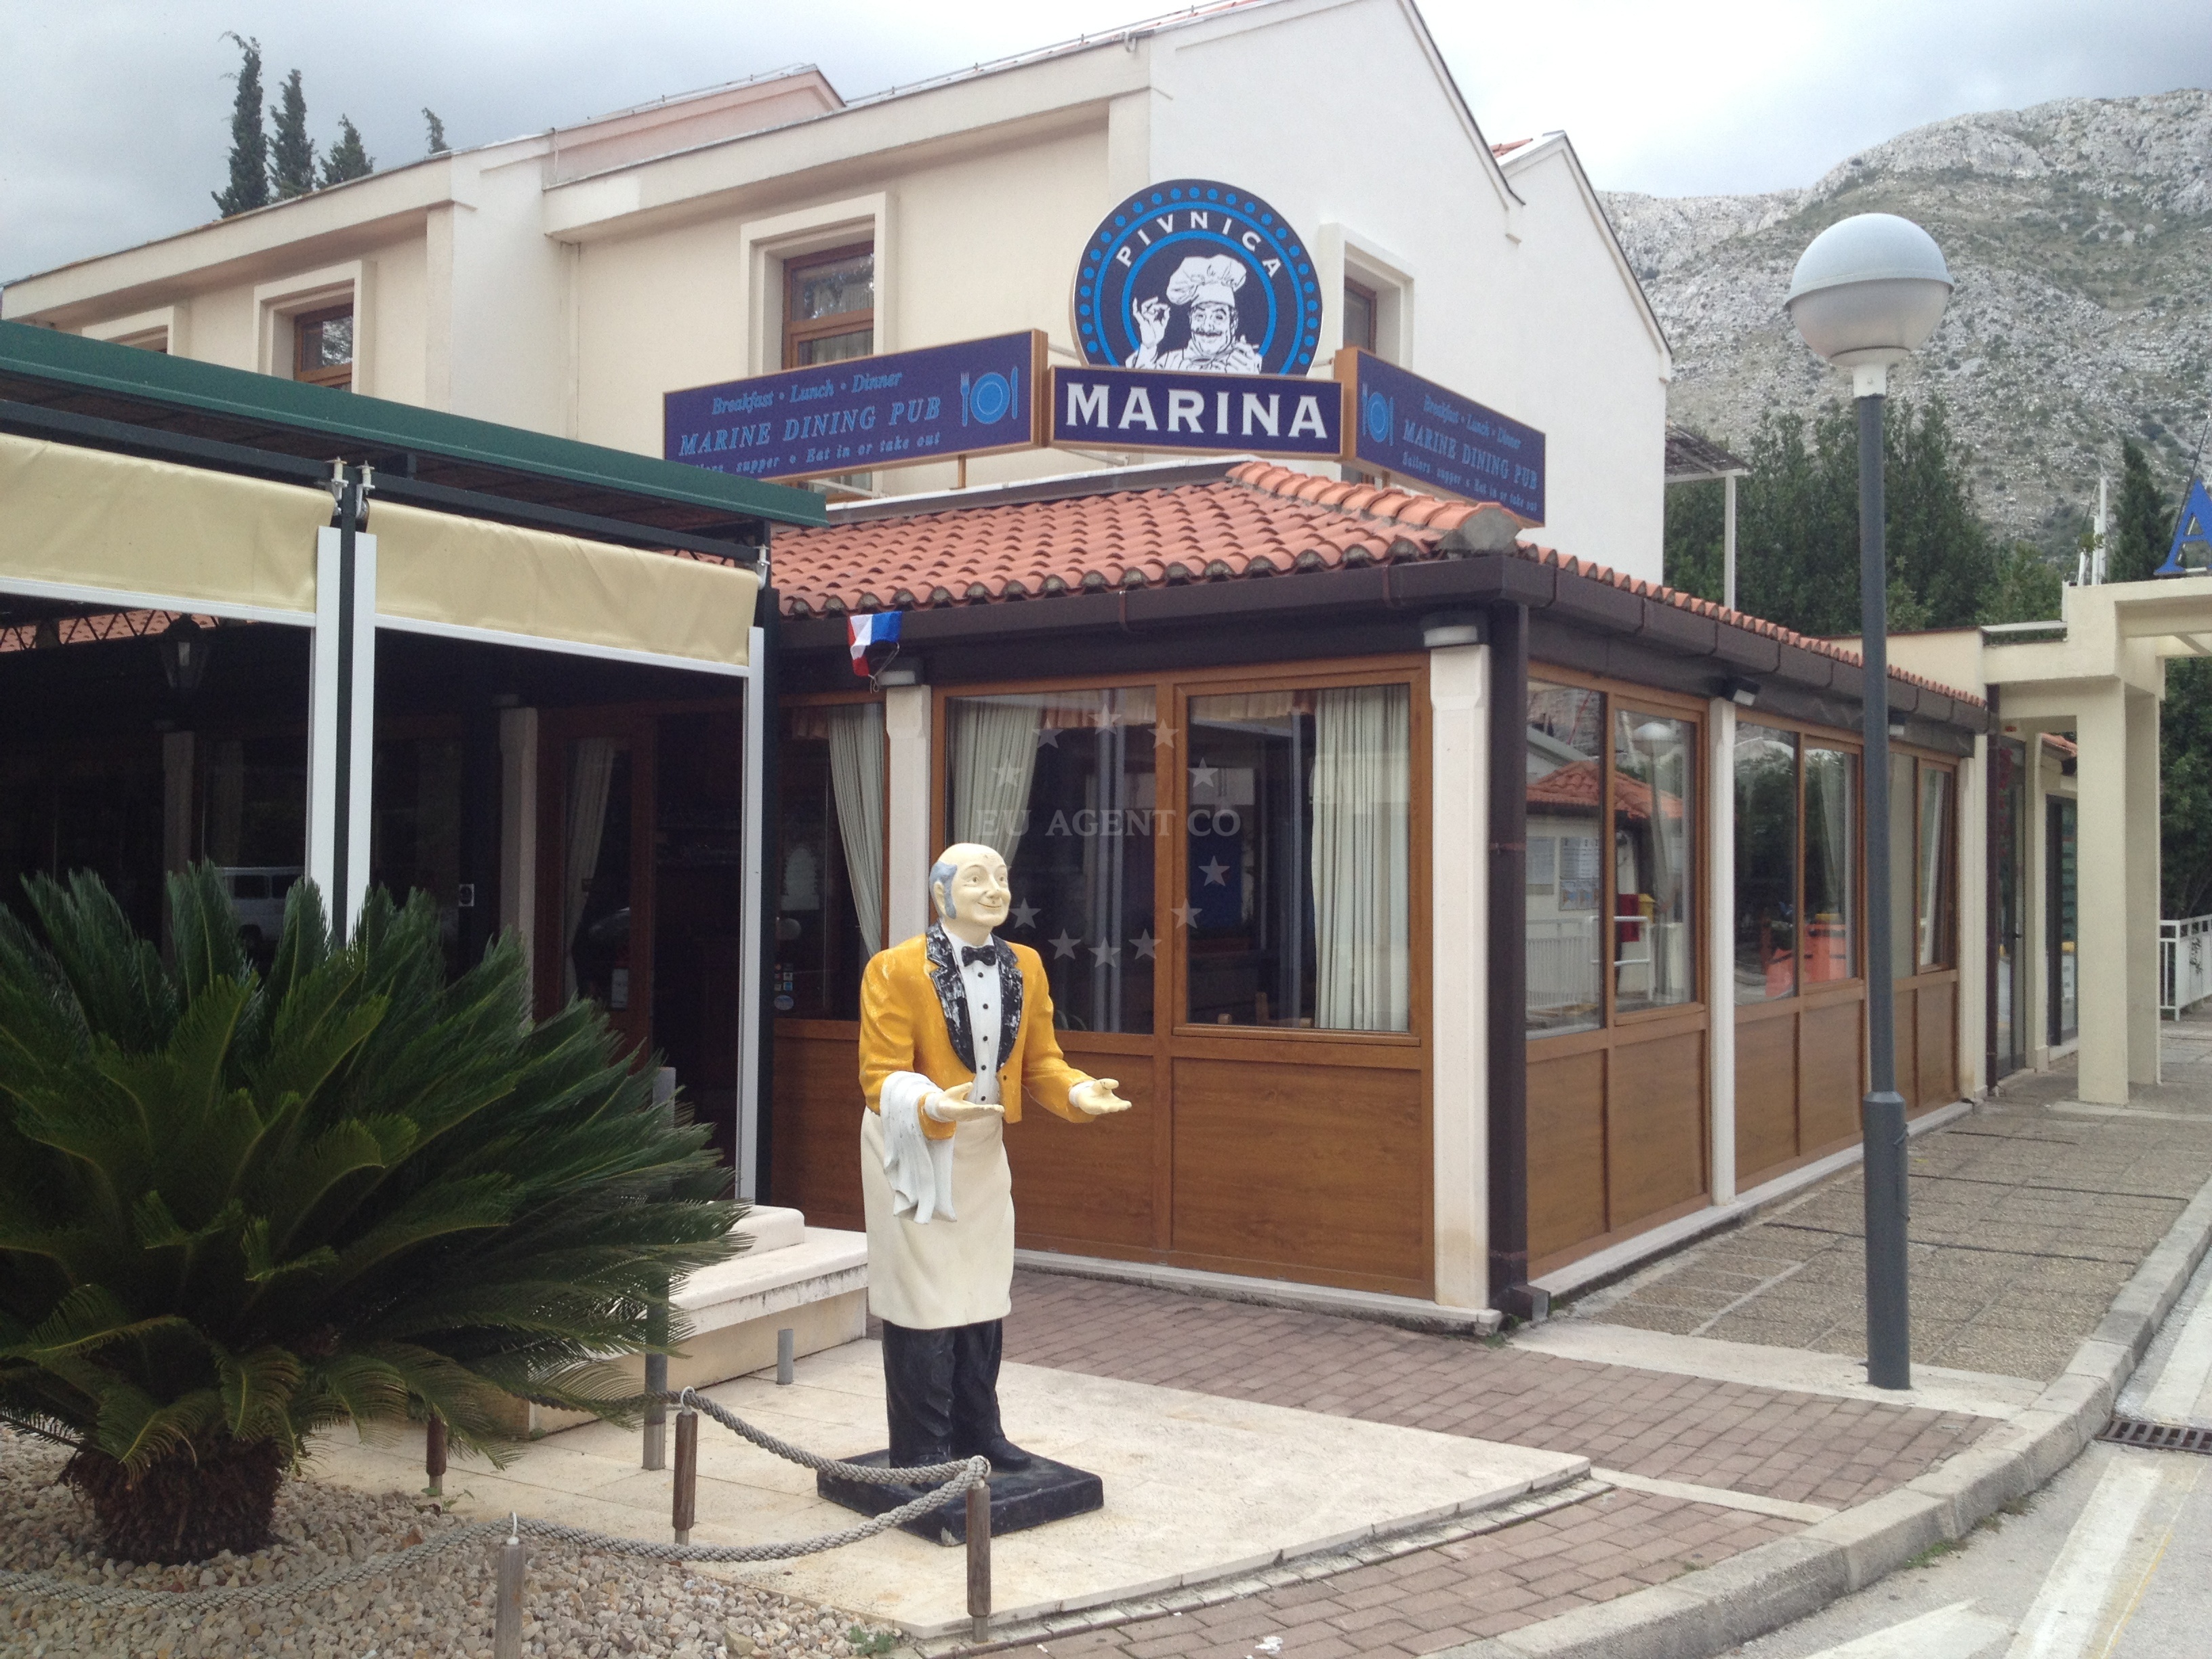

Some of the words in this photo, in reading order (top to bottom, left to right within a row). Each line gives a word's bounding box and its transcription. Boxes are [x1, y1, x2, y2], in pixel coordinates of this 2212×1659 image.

[1115, 211, 1282, 278] PIVNICA
[712, 391, 774, 415] Breakfast
[789, 379, 835, 403] Lunch
[851, 372, 903, 394] Dinner
[1065, 382, 1328, 439] MARINA
[678, 422, 772, 457] MARINE
[782, 405, 876, 441] DINING
[888, 396, 941, 426] PUB
[736, 457, 780, 474] supper
[805, 447, 831, 464] Eat
[836, 444, 851, 459] in
[857, 443, 874, 456] or
[879, 434, 910, 453] take
[916, 430, 941, 447] out
[1403, 419, 1457, 461] MARINE
[1461, 443, 1510, 480] DINING
[1514, 463, 1538, 490] PUB
